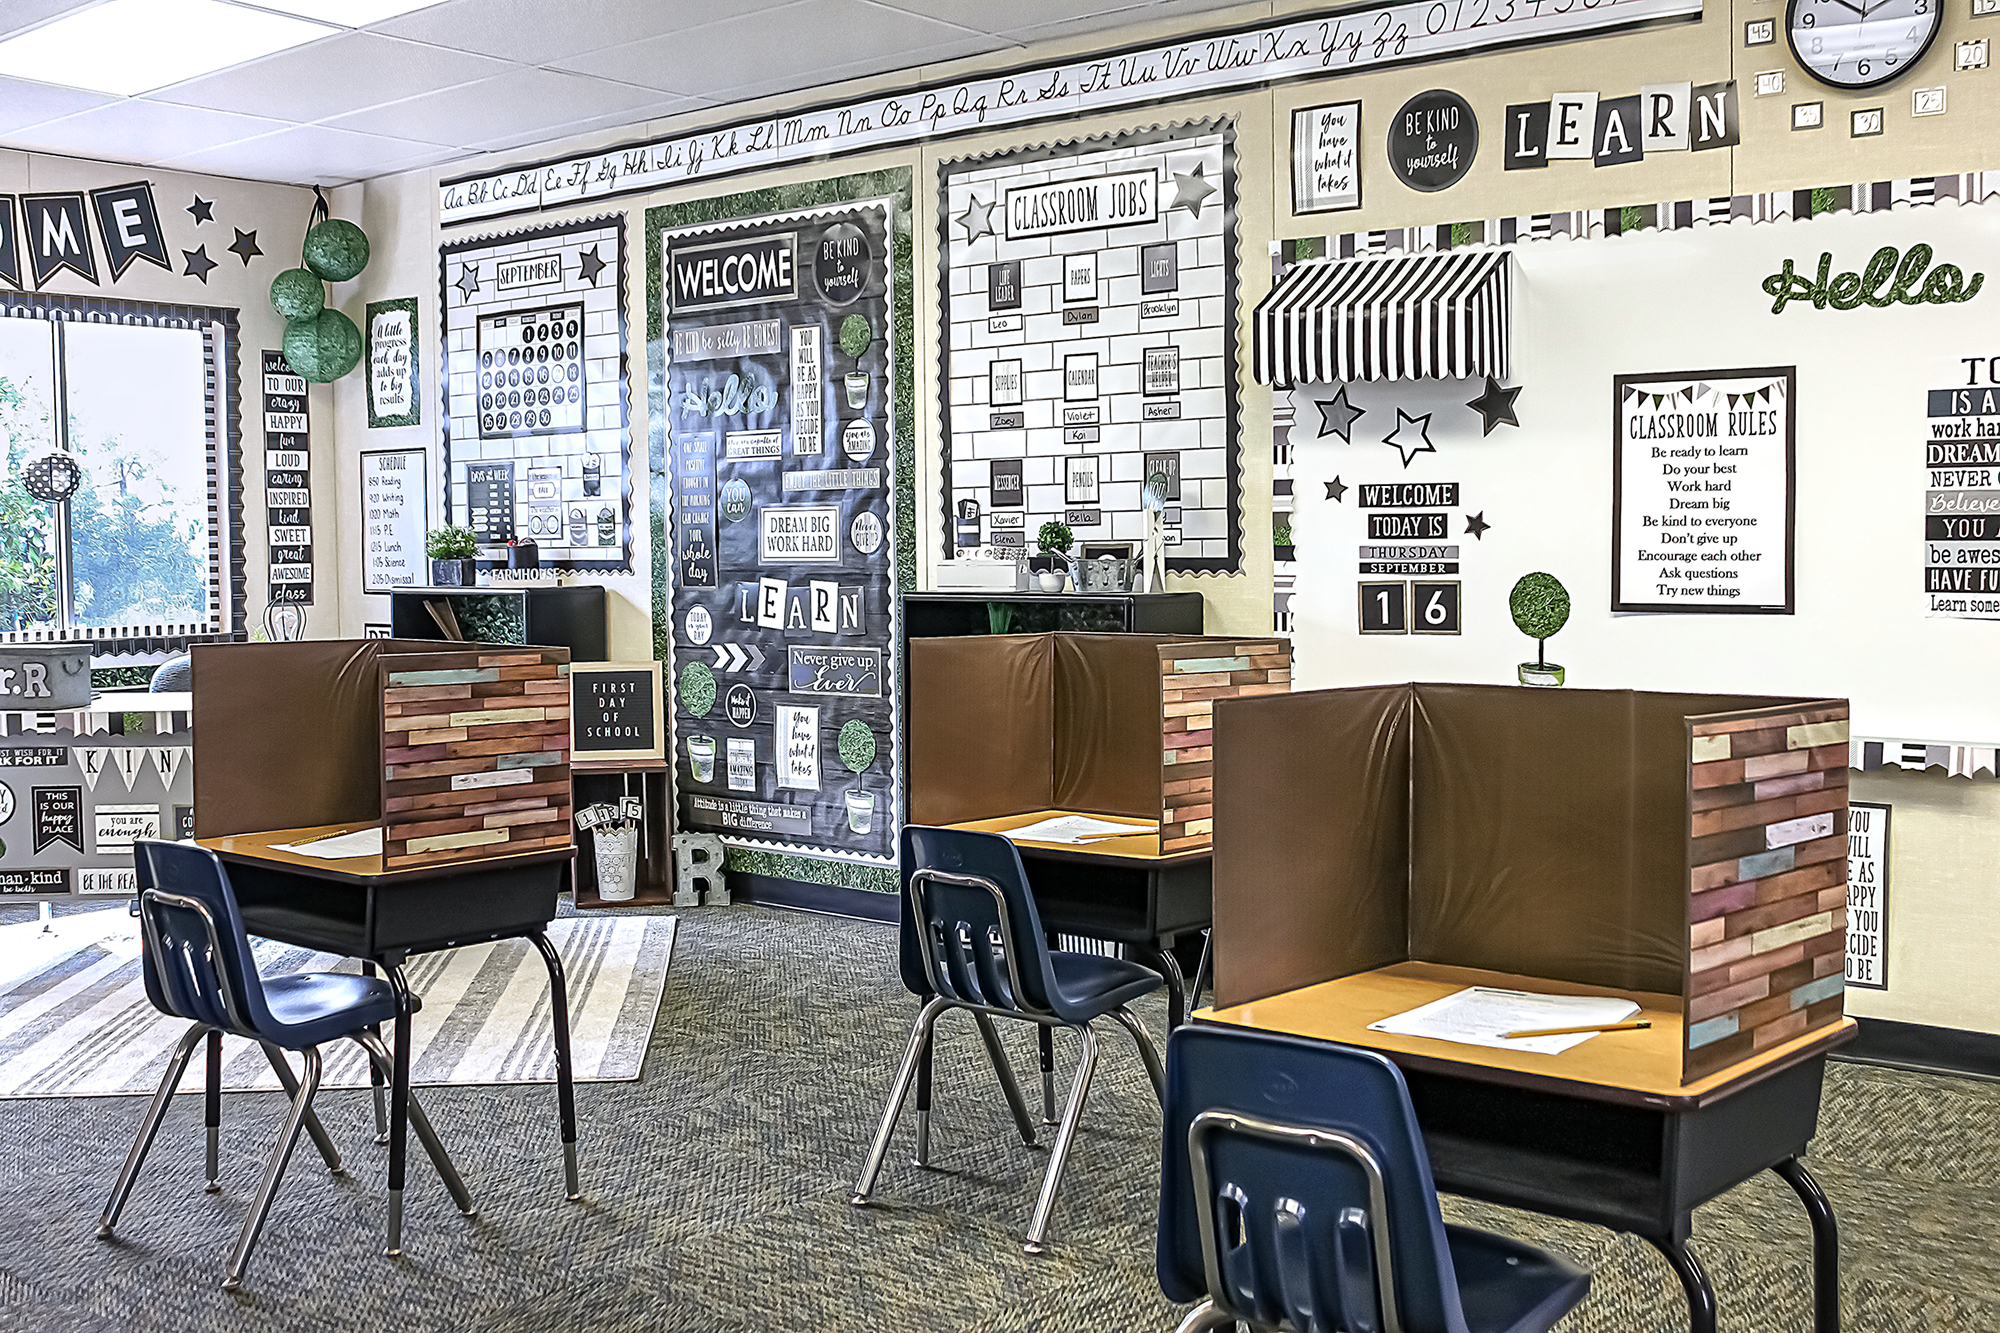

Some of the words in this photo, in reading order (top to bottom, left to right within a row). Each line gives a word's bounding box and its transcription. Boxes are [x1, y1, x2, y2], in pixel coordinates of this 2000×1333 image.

[1803, 13, 1815, 29] 9
[1753, 25, 1770, 39] 45
[1811, 37, 1823, 54] 8
[1831, 53, 1844, 71] 7
[1885, 47, 1897, 65] 5
[1965, 47, 1982, 63] 20
[1858, 59, 1870, 75] 6
[1922, 94, 1940, 109] 25
[1321, 112, 1347, 132] You
[1406, 111, 1422, 136] BE
[1427, 107, 1459, 132] KIND
[1515, 93, 1726, 157] LEARN
[1319, 132, 1348, 149] have
[1426, 134, 1437, 151] to
[1315, 150, 1344, 172] what
[1344, 149, 1354, 168] it
[1407, 143, 1459, 175] yourself
[1317, 174, 1349, 193] takes
[1015, 186, 1099, 231] CLASSROOM
[1109, 179, 1147, 220] JOBS
[0, 199, 146, 257] ME
[823, 241, 834, 260] BE
[838, 238, 859, 257] KIND
[501, 261, 557, 284] SEPTEMBER
[678, 249, 791, 299] WELCOME
[837, 260, 844, 272] to
[1150, 260, 1169, 278] LIGHTS
[824, 270, 859, 292] yourself
[1071, 268, 1090, 285] PAPERS
[1762, 243, 1984, 314] Hello
[1068, 312, 1092, 322] Dylan
[1143, 304, 1176, 315] Brooklyn
[993, 319, 1007, 328] Leo
[267, 377, 279, 391] TO
[286, 378, 304, 392] OUR
[1068, 369, 1095, 386] CALENDAR
[271, 397, 299, 412] crazy
[1952, 390, 1972, 415] IS
[1982, 390, 1996, 414] A
[1067, 411, 1095, 421] Violet
[1148, 407, 1172, 416] Asher
[271, 415, 302, 429] HAPPY
[995, 417, 1015, 426] Zoey
[1630, 413, 1718, 439] CLASSROOM
[1729, 410, 1776, 436] RULES
[1932, 418, 1971, 438] work
[280, 433, 295, 449] fun
[752, 446, 780, 455] THINGS
[1651, 447, 1667, 458] Be
[1670, 446, 1701, 459] ready
[1704, 447, 1715, 457] to
[1719, 445, 1748, 456] learn
[276, 454, 300, 467] LOUD
[379, 456, 406, 470] SCHEDULE
[1663, 464, 1680, 474] Do
[1684, 465, 1710, 476] your
[1713, 463, 1737, 473] best
[272, 473, 302, 487] caring
[1072, 472, 1093, 488] PENCILS
[1667, 481, 1701, 491] Work
[1705, 480, 1731, 491] hard
[1931, 471, 1991, 487] NEVER
[270, 492, 307, 505] INSPIRED
[727, 488, 745, 503] YOU
[1364, 485, 1452, 506] WELCOME
[727, 500, 745, 514] can
[1670, 499, 1709, 509] Dream
[1713, 498, 1730, 510] big
[771, 517, 808, 533] DREAM
[811, 517, 830, 532] BIG
[994, 514, 1019, 525] Xavier
[1069, 512, 1094, 523] Bella
[1643, 516, 1658, 527] Be
[1662, 515, 1686, 526] kind
[1691, 517, 1702, 526] to
[1705, 517, 1757, 528] everyone
[1373, 517, 1422, 537] TODAY
[1429, 516, 1442, 536] IS
[1943, 519, 1985, 538] YOU
[275, 529, 306, 542] SWEET
[994, 535, 1015, 544] Elena
[1661, 533, 1694, 543] Don't
[1697, 533, 1719, 545] give
[1723, 536, 1738, 545] up
[384, 540, 401, 552] Lunch
[682, 544, 711, 560] whole
[767, 536, 799, 552] WORK
[802, 536, 833, 551] HARD
[278, 545, 304, 563] great
[1369, 547, 1448, 558] THURSDAY
[1638, 551, 1697, 563] Encourage
[1701, 551, 1726, 561] each
[1731, 551, 1761, 561] other
[1930, 544, 1951, 563] be
[272, 568, 310, 580] AWESOME
[492, 568, 559, 580] FARMHOUSE
[689, 565, 708, 583] day
[1371, 564, 1446, 572] SEPTEMBER
[1659, 568, 1682, 578] Ask
[1685, 567, 1738, 580] questions
[385, 573, 414, 585] Dismissal
[1931, 570, 1972, 590] HAVE
[1656, 584, 1678, 597] Try
[1681, 587, 1704, 596] new
[1708, 585, 1740, 598] things
[740, 586, 858, 629] LEARN
[1377, 590, 1389, 624] 1
[1425, 590, 1447, 625] 6
[1931, 595, 1966, 612] Learn
[793, 652, 827, 665] Never
[830, 653, 854, 670] give
[858, 656, 876, 670] up.
[795, 666, 875, 691] Ever.
[592, 683, 635, 693] FIRST
[599, 698, 626, 708] DAY
[603, 712, 618, 722] OF
[794, 712, 810, 727] You
[587, 726, 640, 737] SCHOOL
[792, 726, 811, 741] have
[15, 756, 42, 765] FOR
[46, 756, 58, 764] IT
[791, 763, 812, 776] takes
[42, 813, 73, 825] happy
[111, 817, 126, 825] you
[130, 816, 143, 825] are
[723, 814, 737, 827] BIG
[740, 816, 772, 830] difference
[43, 825, 73, 833] PLACE
[99, 823, 158, 840] enough
[673, 833, 730, 906] R
[1859, 862, 1874, 882] AS
[84, 875, 94, 890] BE
[98, 874, 114, 890] THE
[1855, 911, 1878, 932] YOU
[1858, 959, 1872, 980] BE
